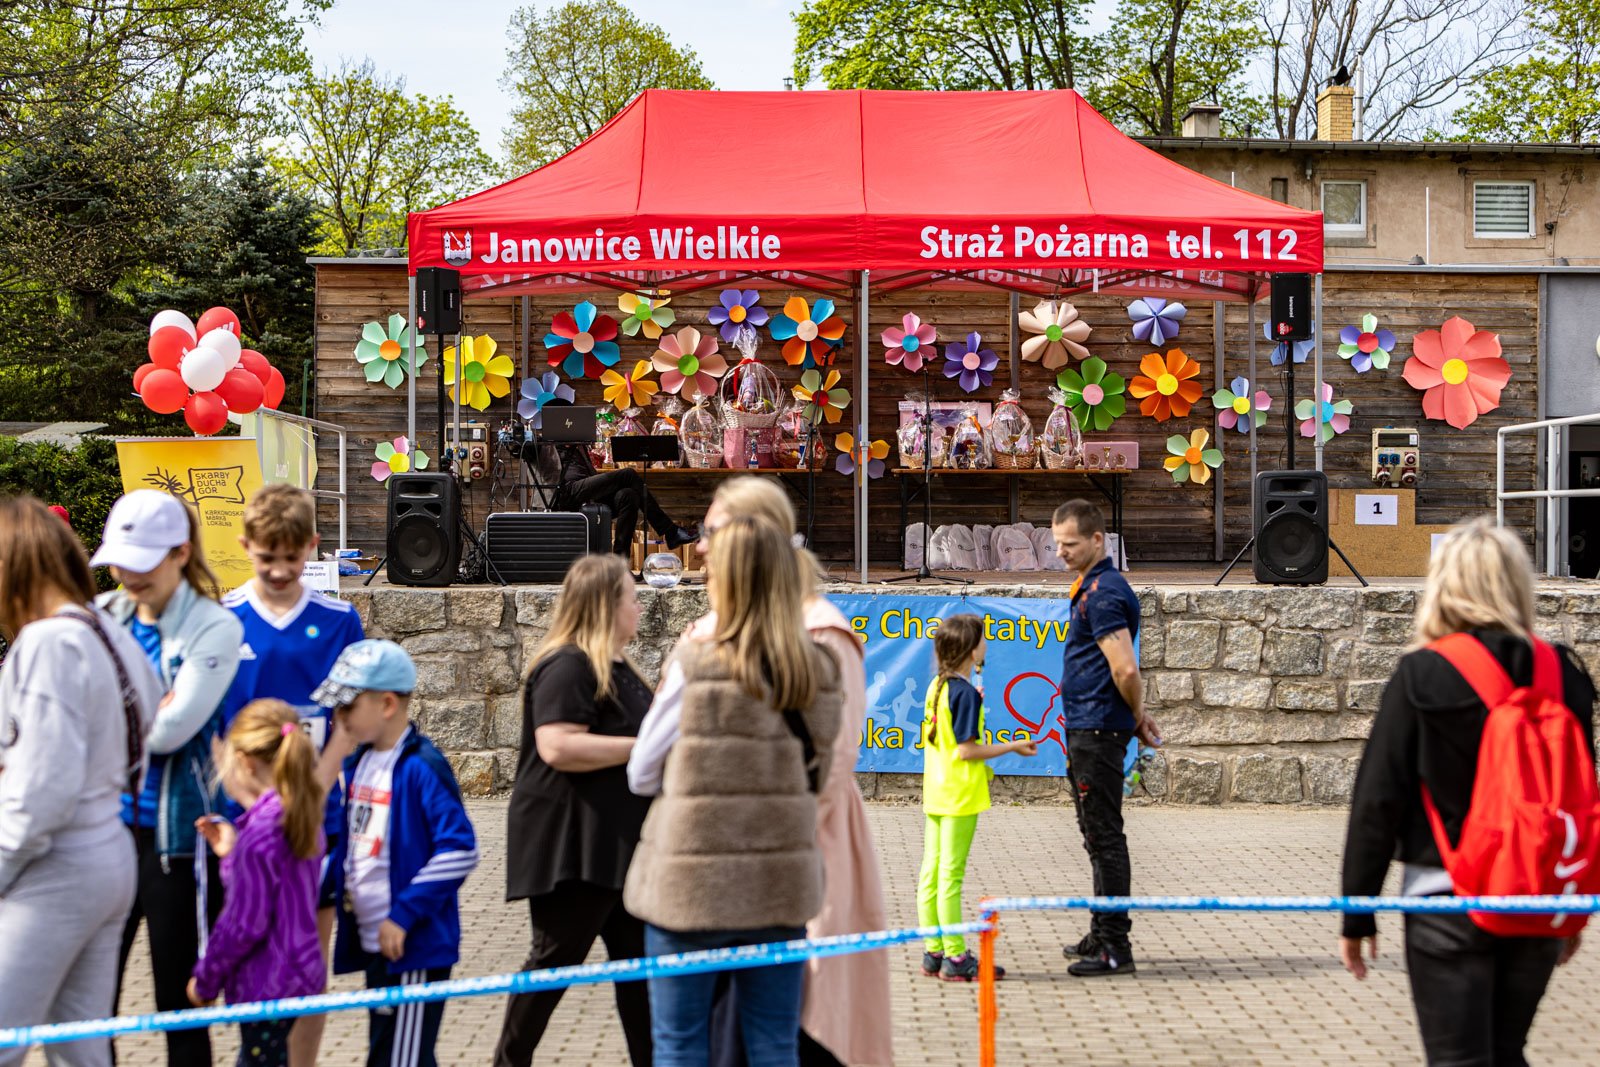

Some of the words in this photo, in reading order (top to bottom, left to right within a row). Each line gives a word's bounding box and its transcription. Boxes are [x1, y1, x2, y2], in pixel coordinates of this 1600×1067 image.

[480, 227, 641, 264] Janowice
[649, 225, 781, 260] Wielkie
[919, 224, 1004, 259] Straż
[1014, 224, 1149, 259] Pożarna
[1167, 226, 1223, 260] tel.
[1233, 228, 1298, 261] 112
[1373, 502, 1383, 515] 1
[858, 718, 904, 750] ka
